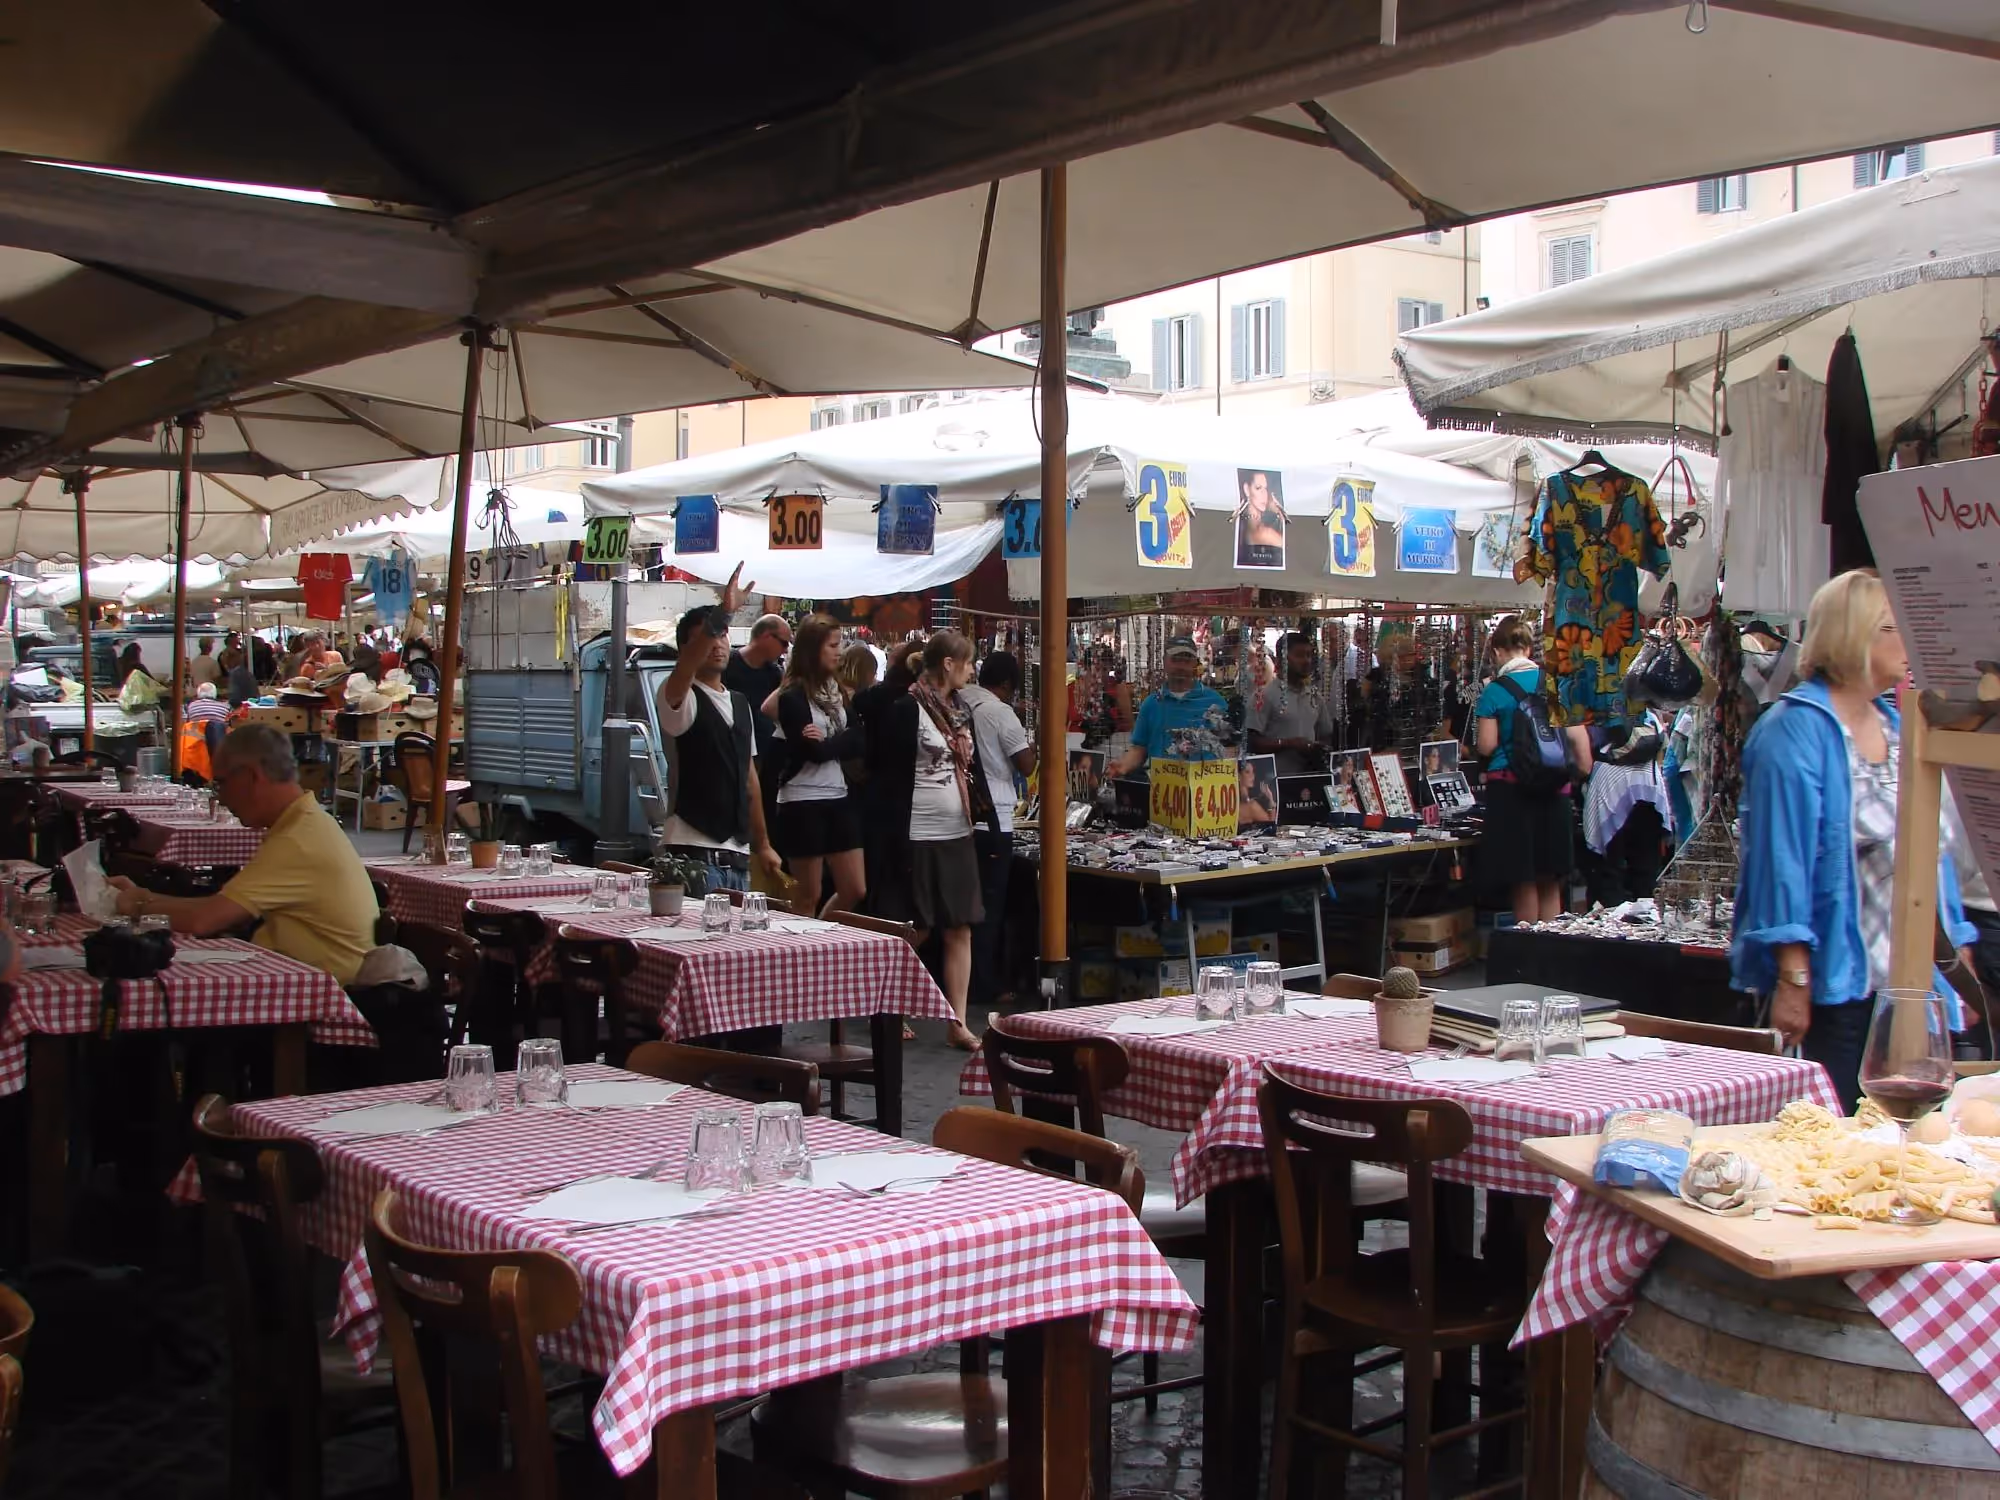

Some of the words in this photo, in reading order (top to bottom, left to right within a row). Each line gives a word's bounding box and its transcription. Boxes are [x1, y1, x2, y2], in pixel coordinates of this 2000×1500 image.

[771, 498, 821, 545] 3.00
[1139, 465, 1168, 561] 3
[1169, 470, 1187, 488] EURO
[1331, 483, 1357, 570] 3
[587, 520, 629, 559] 3.00
[382, 568, 401, 594] 18
[1152, 783, 1160, 816] €
[1162, 784, 1187, 825] 4,00
[1195, 786, 1204, 819] €
[1208, 784, 1237, 825] 4,00
